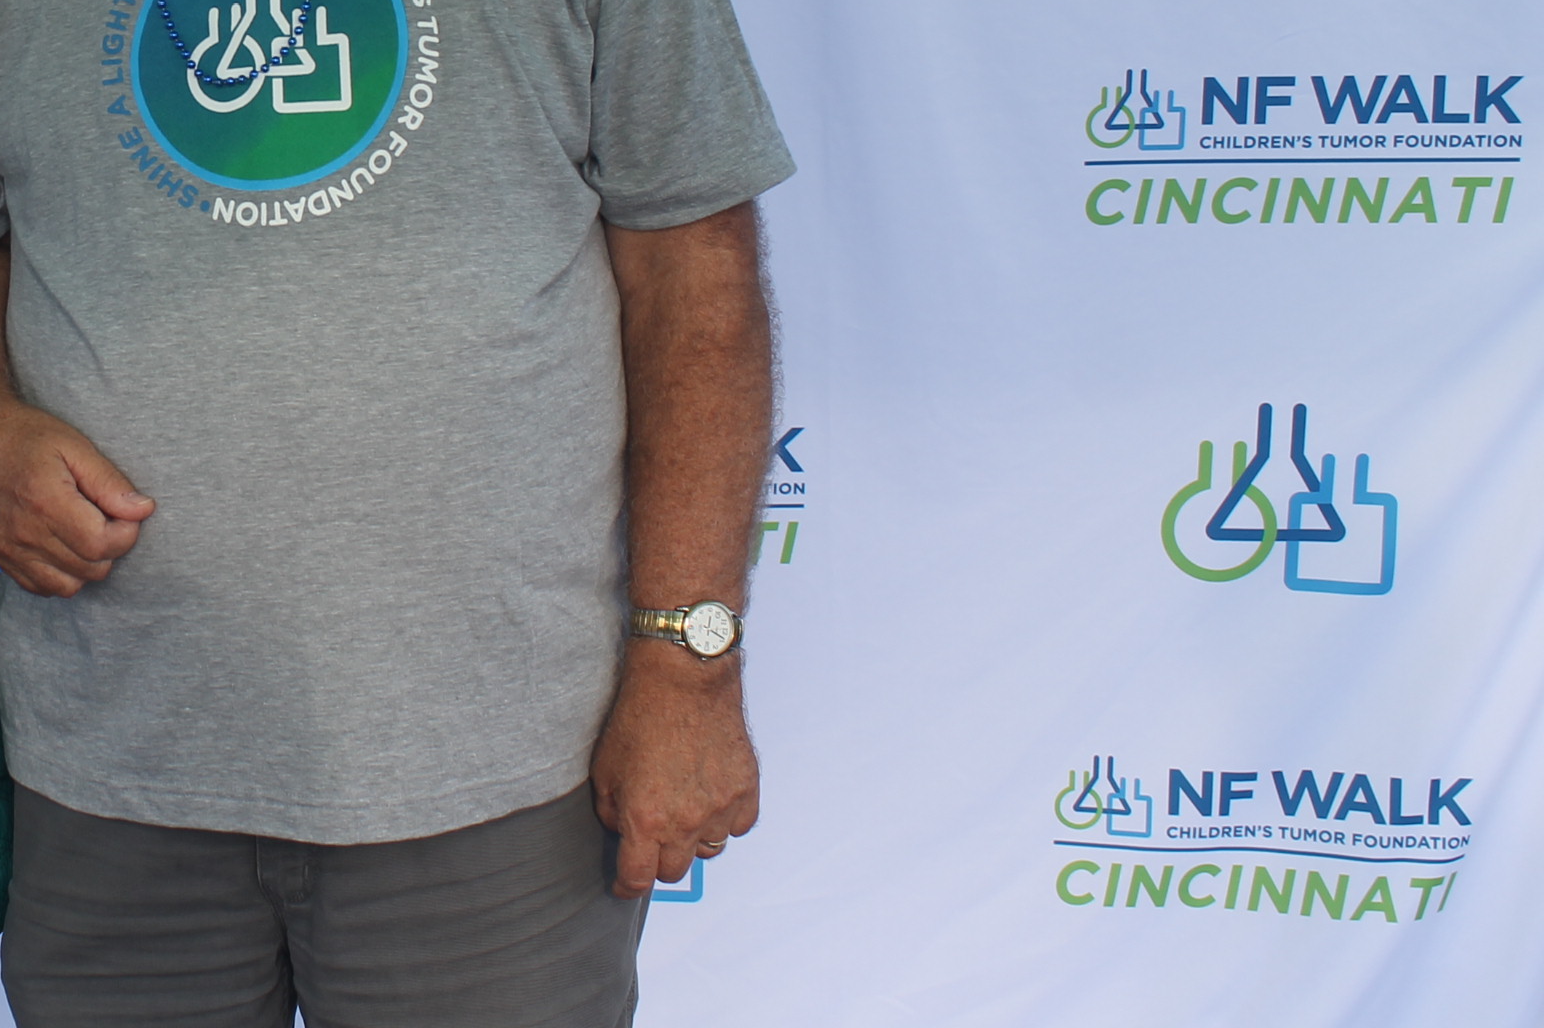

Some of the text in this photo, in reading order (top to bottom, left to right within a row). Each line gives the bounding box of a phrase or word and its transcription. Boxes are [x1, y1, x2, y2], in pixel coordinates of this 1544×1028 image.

[395, 14, 441, 132] TUMOR
[106, 93, 133, 117] A
[1202, 75, 1523, 125] NF WALK
[116, 122, 202, 211] SHINE
[1200, 135, 1522, 149] CHILDREN'S TUMOR FOUNDATION
[210, 129, 410, 229] FOUNDATION
[1085, 177, 1514, 225] CINCINNATI
[1168, 769, 1472, 826] NF WALK
[1167, 826, 1470, 849] CHILDREN'S TUMOR FOUNDATION
[1056, 860, 1457, 923] CINCINNATI
